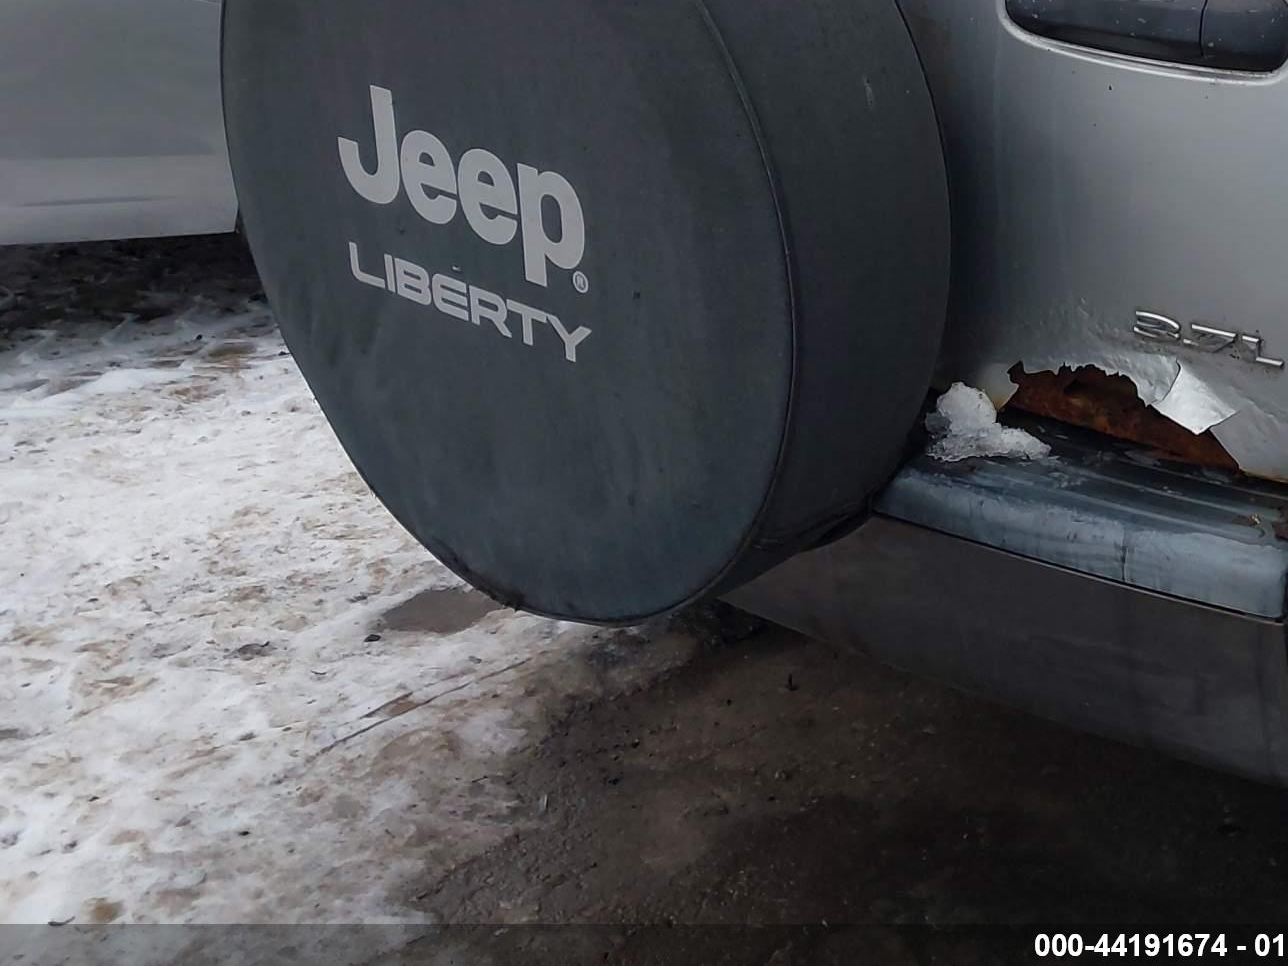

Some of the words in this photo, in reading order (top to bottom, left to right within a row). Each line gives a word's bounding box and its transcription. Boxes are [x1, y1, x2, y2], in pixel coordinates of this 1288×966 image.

[337, 84, 586, 288] Jeep
[348, 241, 593, 363] LIBERTY
[1133, 309, 1285, 369] 3.7L
